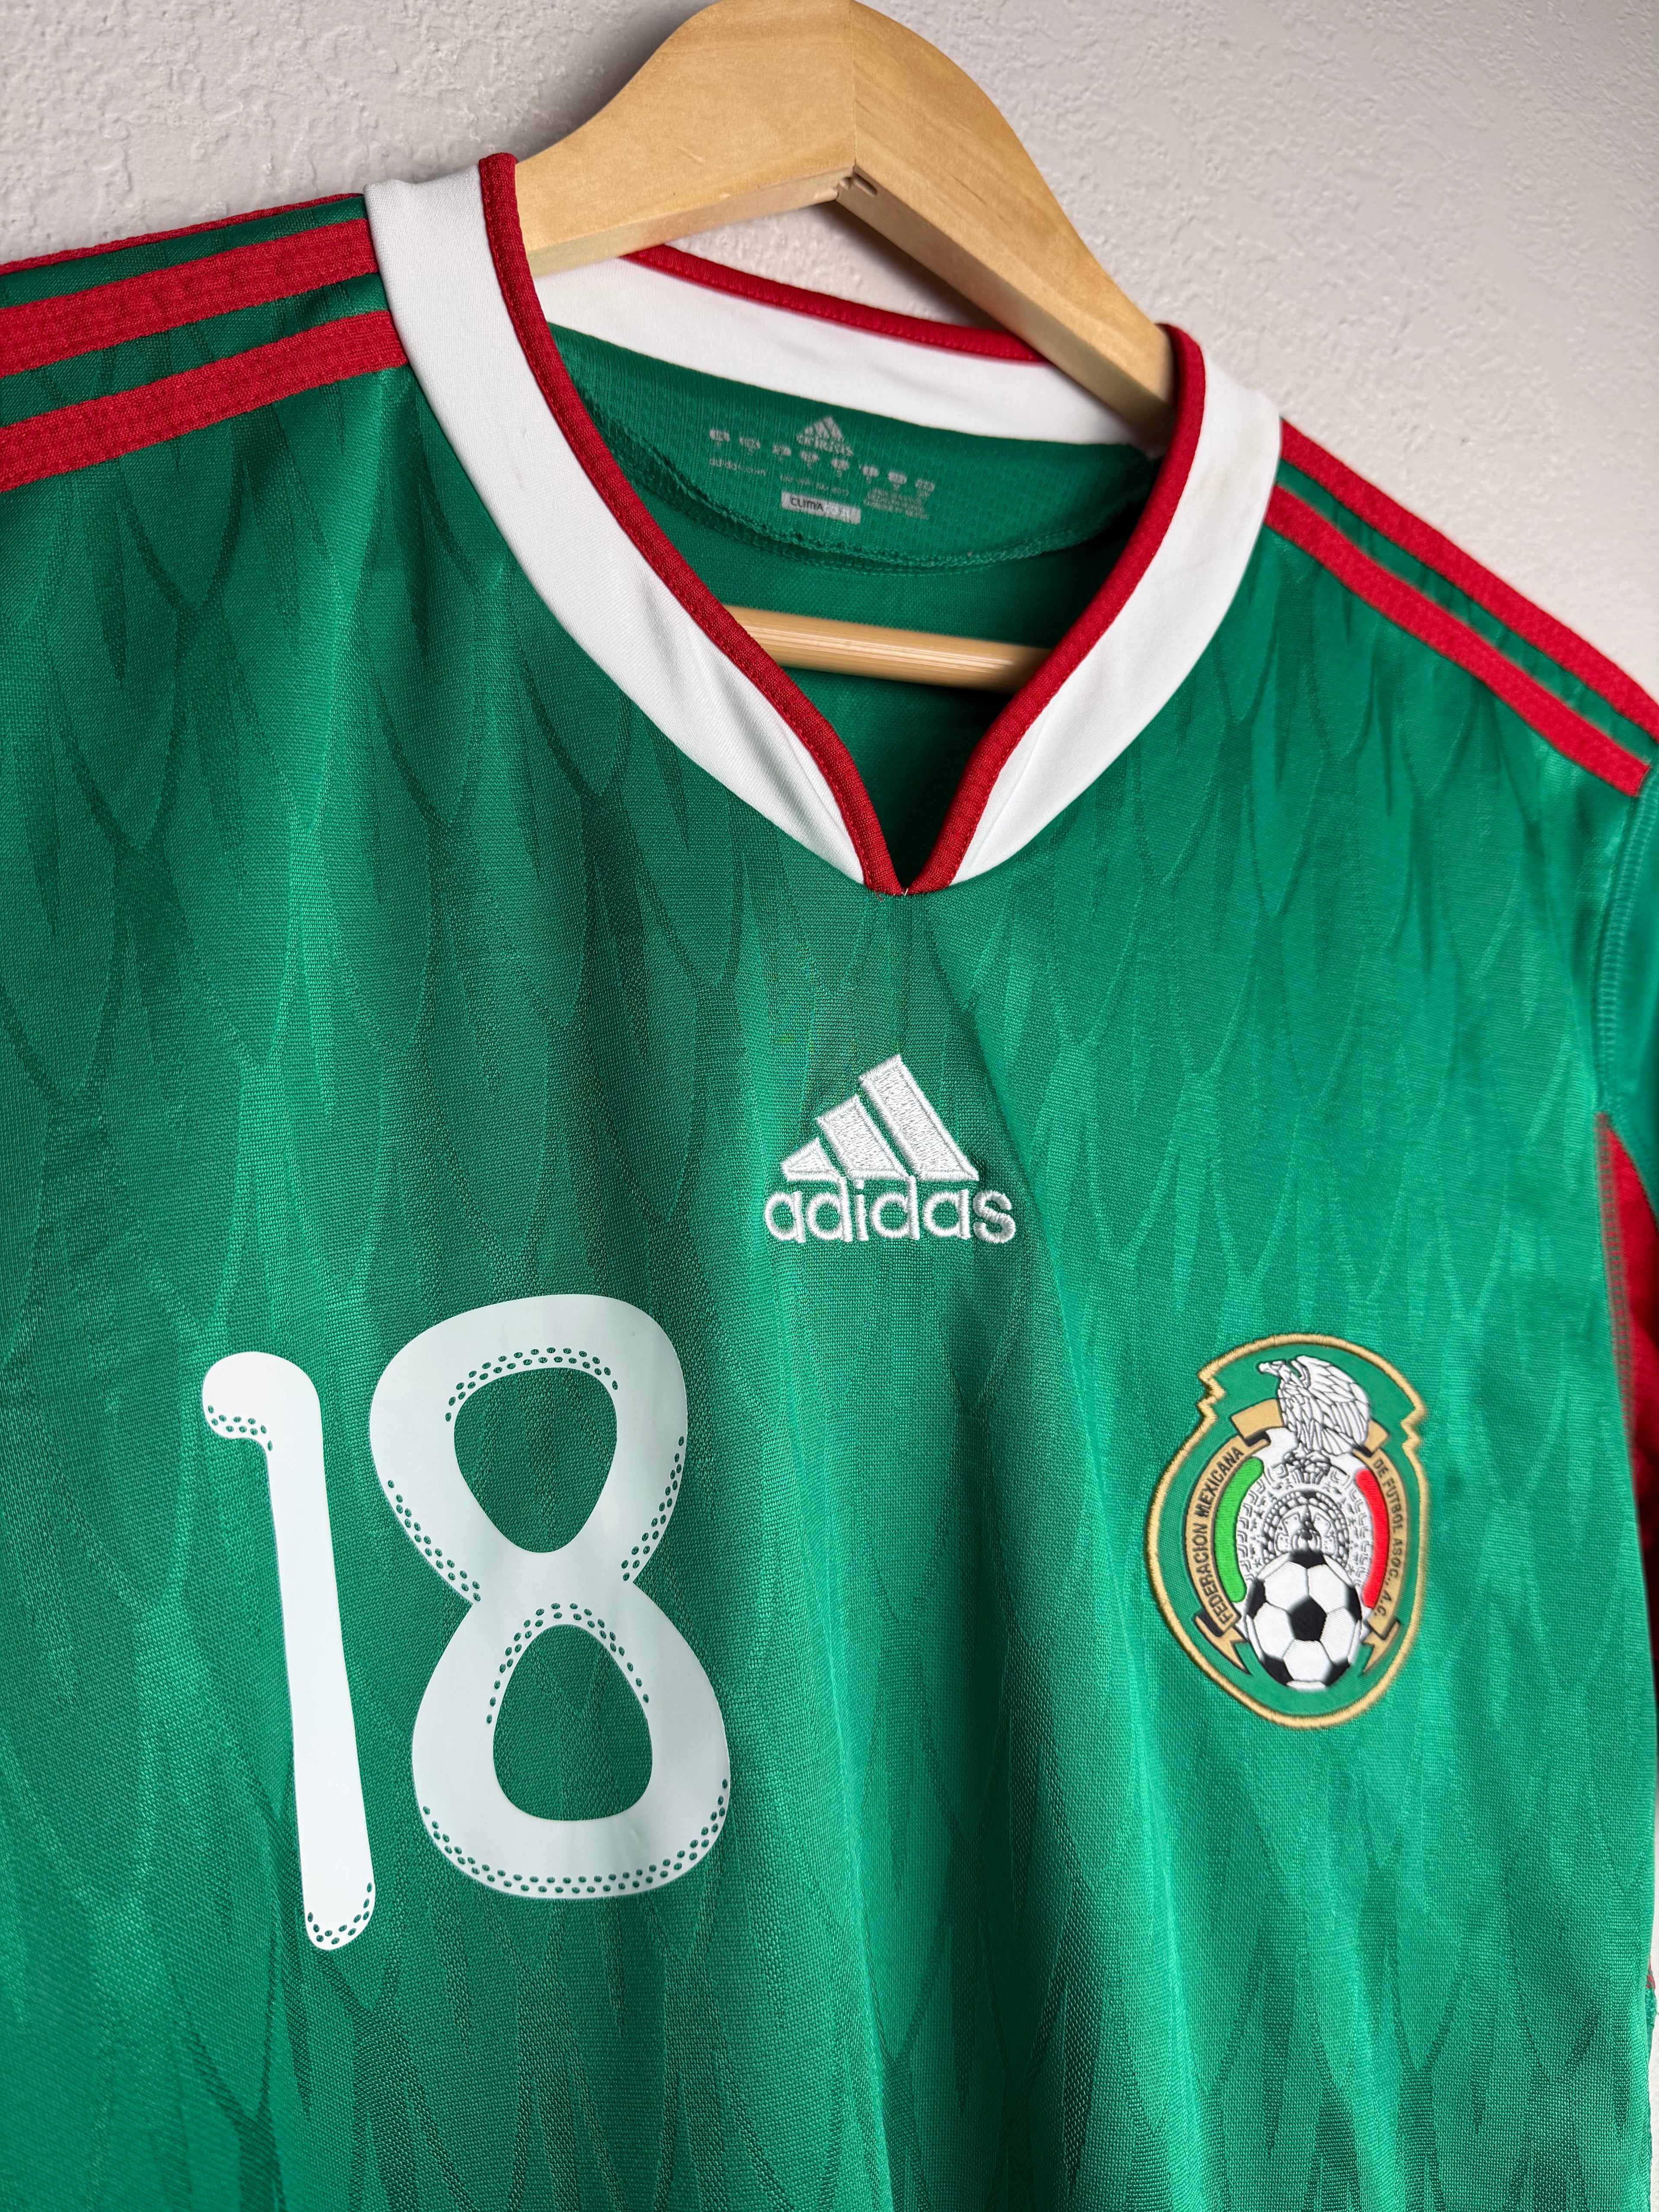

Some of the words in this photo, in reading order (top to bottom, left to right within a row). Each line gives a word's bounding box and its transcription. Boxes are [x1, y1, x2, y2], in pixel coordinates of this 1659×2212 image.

[764, 1176, 1016, 1244] adidas
[1194, 1447, 1244, 1518] MEXICANA
[1373, 1458, 1389, 1478] DE
[1382, 1477, 1403, 1533] FUTBOL
[1191, 1522, 1233, 1625] FEDERACION
[201, 1294, 731, 1951] 18
